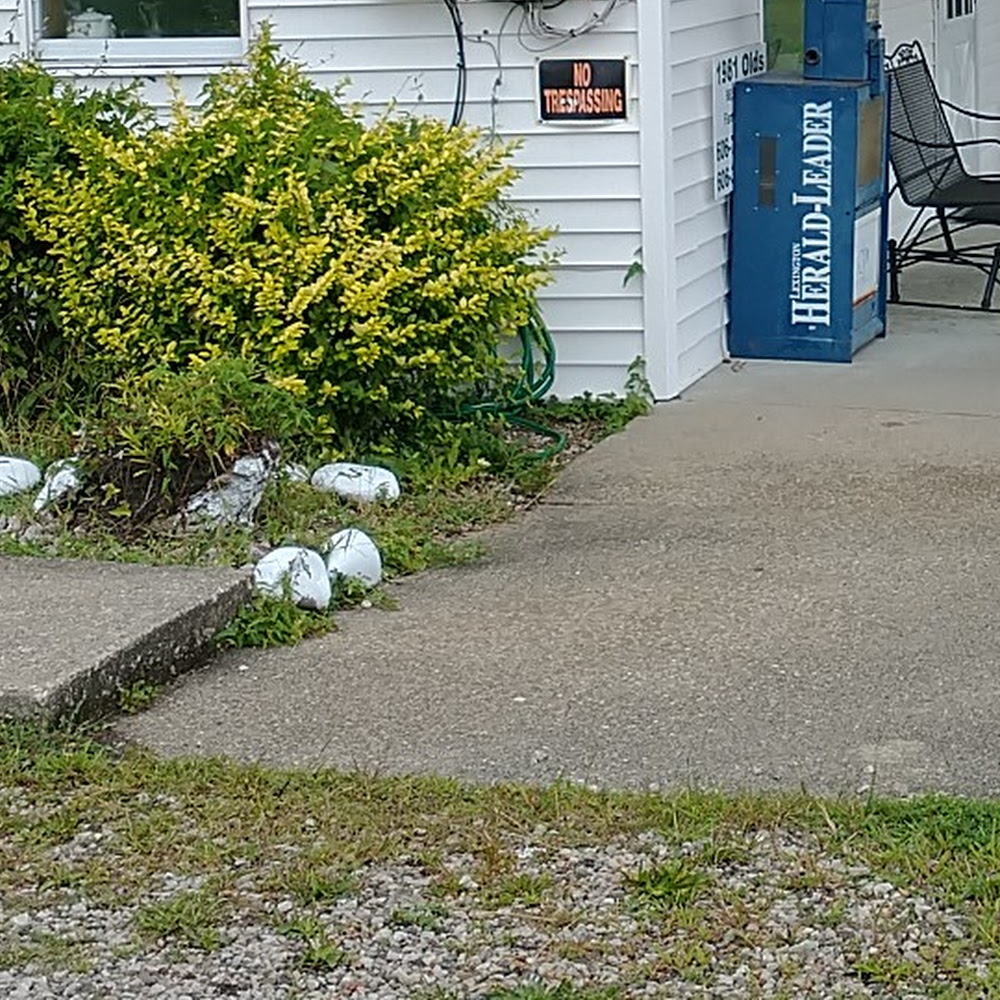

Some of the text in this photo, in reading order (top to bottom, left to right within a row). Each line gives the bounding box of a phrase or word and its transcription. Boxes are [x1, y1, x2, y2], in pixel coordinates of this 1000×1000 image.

[573, 63, 591, 87] NO
[741, 50, 764, 77] Olds
[543, 89, 623, 114] TRESPASSING
[791, 101, 832, 327] HERALD-LEADER
